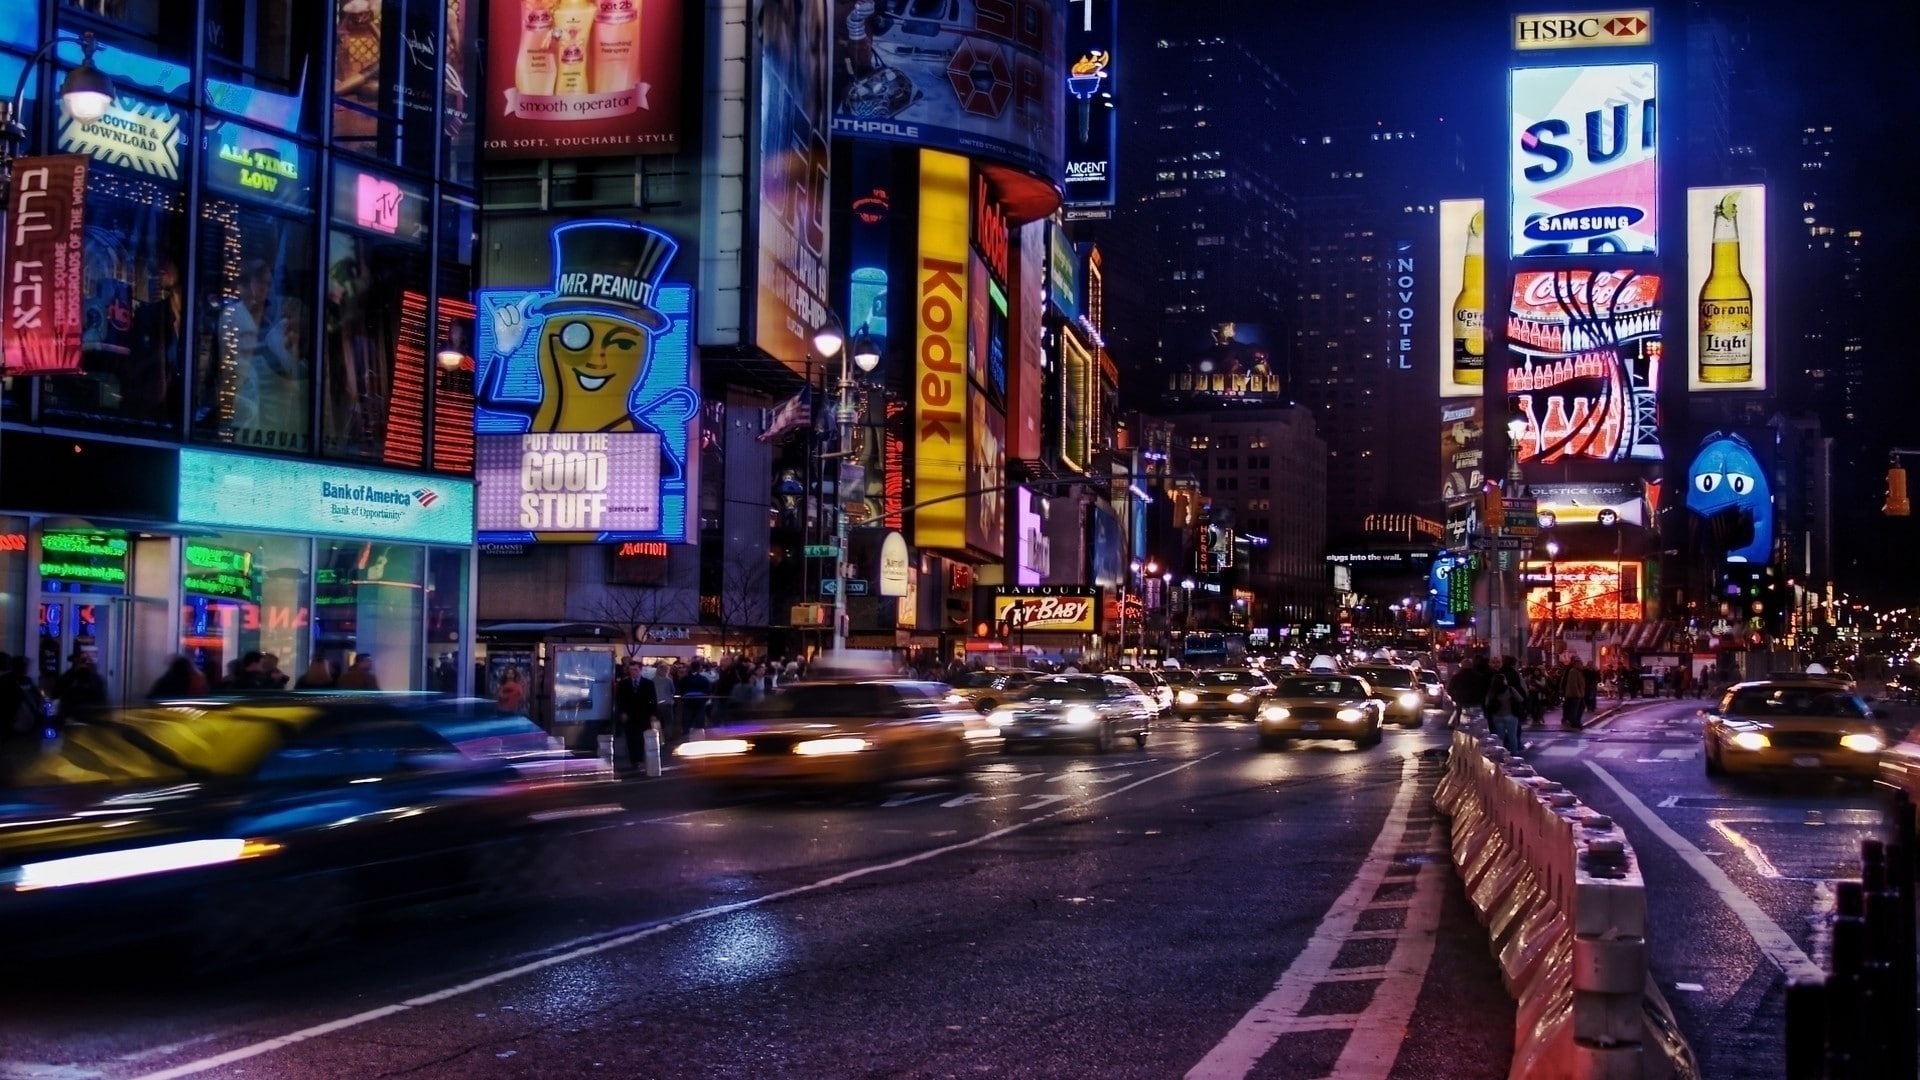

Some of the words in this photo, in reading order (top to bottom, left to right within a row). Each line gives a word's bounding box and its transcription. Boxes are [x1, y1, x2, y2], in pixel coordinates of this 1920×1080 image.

[1518, 18, 1599, 40] HSBC
[520, 99, 568, 113] smooth
[573, 95, 633, 114] operator
[98, 113, 149, 136] COVER
[81, 123, 157, 152] DOWNLOAD
[484, 140, 508, 149] FOR
[555, 135, 631, 146] TOUCHABLE
[637, 133, 675, 143] STYLE
[959, 138, 985, 149] UNITED
[219, 143, 253, 167] ALL
[254, 151, 298, 179] TIME
[1065, 161, 1108, 174] ARGENT
[72, 165, 85, 206] WORLD
[240, 168, 278, 192] LOW
[358, 173, 403, 234] MTV
[71, 206, 83, 230] THE
[1538, 216, 1629, 231] SAMSUNG
[70, 230, 81, 249] OF
[55, 242, 67, 289] SQUARE
[69, 250, 81, 326] CROSSROADS
[560, 273, 588, 295] MR.
[590, 273, 652, 305] PEANUT
[54, 289, 66, 326] TIMES
[1397, 258, 1414, 369] NOVOTEL
[1702, 303, 1750, 318] Corona
[919, 257, 964, 445] Kodak
[1706, 334, 1747, 352] Light
[523, 434, 550, 450] PUT
[553, 434, 580, 450] OUT
[584, 434, 609, 450] THE
[521, 452, 608, 491] GOOD
[323, 481, 352, 500] Bank
[352, 486, 366, 500] of
[366, 486, 411, 506] America
[331, 503, 350, 516] Bank
[351, 506, 360, 516] of
[360, 507, 402, 521] Opportunity
[520, 493, 608, 528] STUFF
[1497, 539, 1518, 547] WAY
[1350, 553, 1367, 561] into
[1367, 553, 1382, 561] the
[1382, 553, 1402, 561] wall.
[995, 586, 1097, 594] MARQUIS
